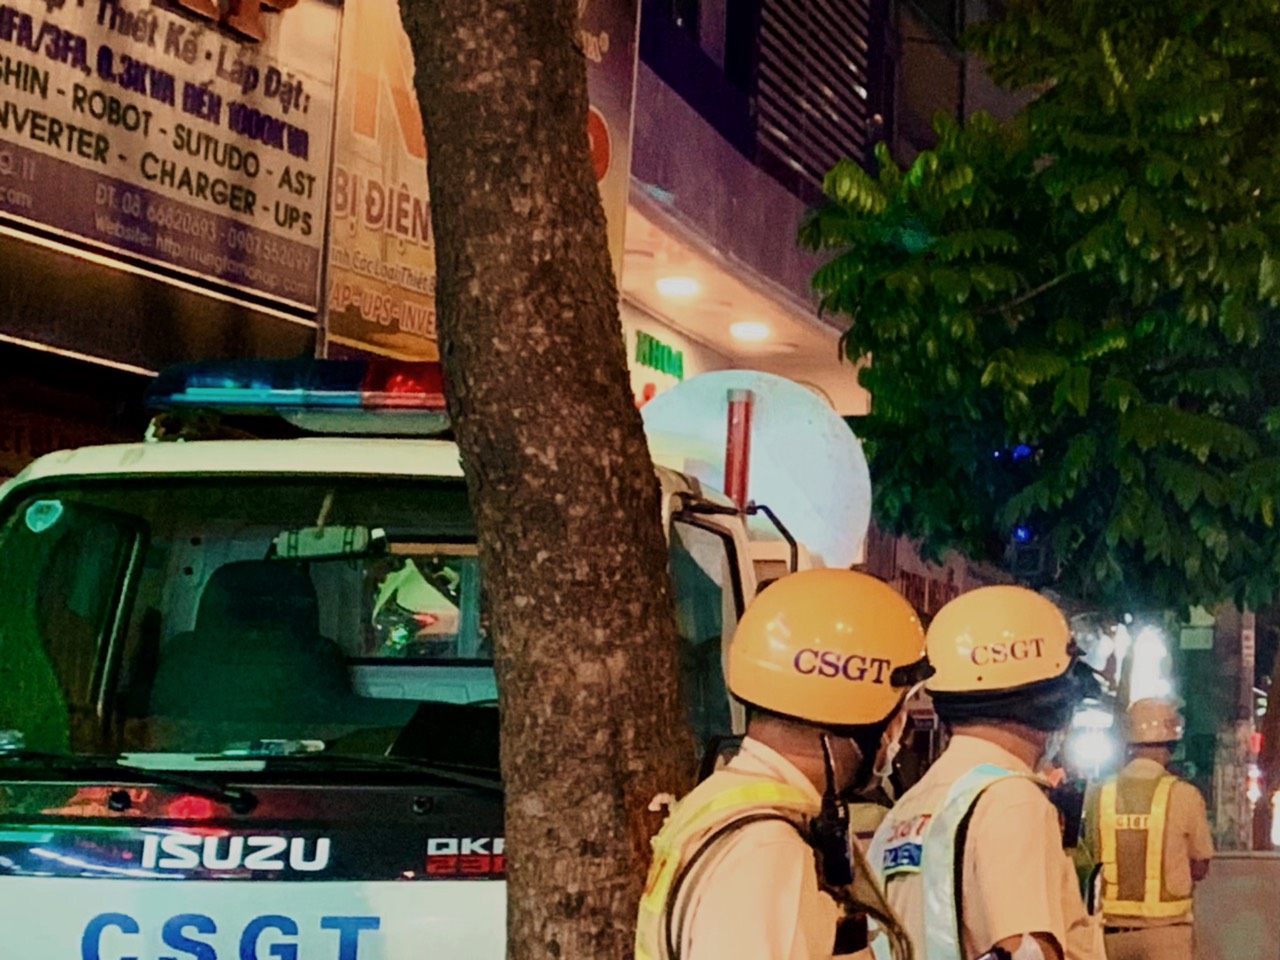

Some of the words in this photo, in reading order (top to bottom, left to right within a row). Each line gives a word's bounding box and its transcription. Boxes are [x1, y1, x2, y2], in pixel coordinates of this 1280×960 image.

[0, 55, 49, 100] HIN
[72, 83, 153, 137] ROBOT
[173, 123, 260, 178] SUTUDO
[278, 166, 316, 200] AST
[141, 152, 257, 215] CHARGER
[274, 201, 313, 236] UPS
[793, 648, 891, 684] CSGT
[971, 638, 1045, 666] CSGT
[141, 835, 330, 872] ISUZU
